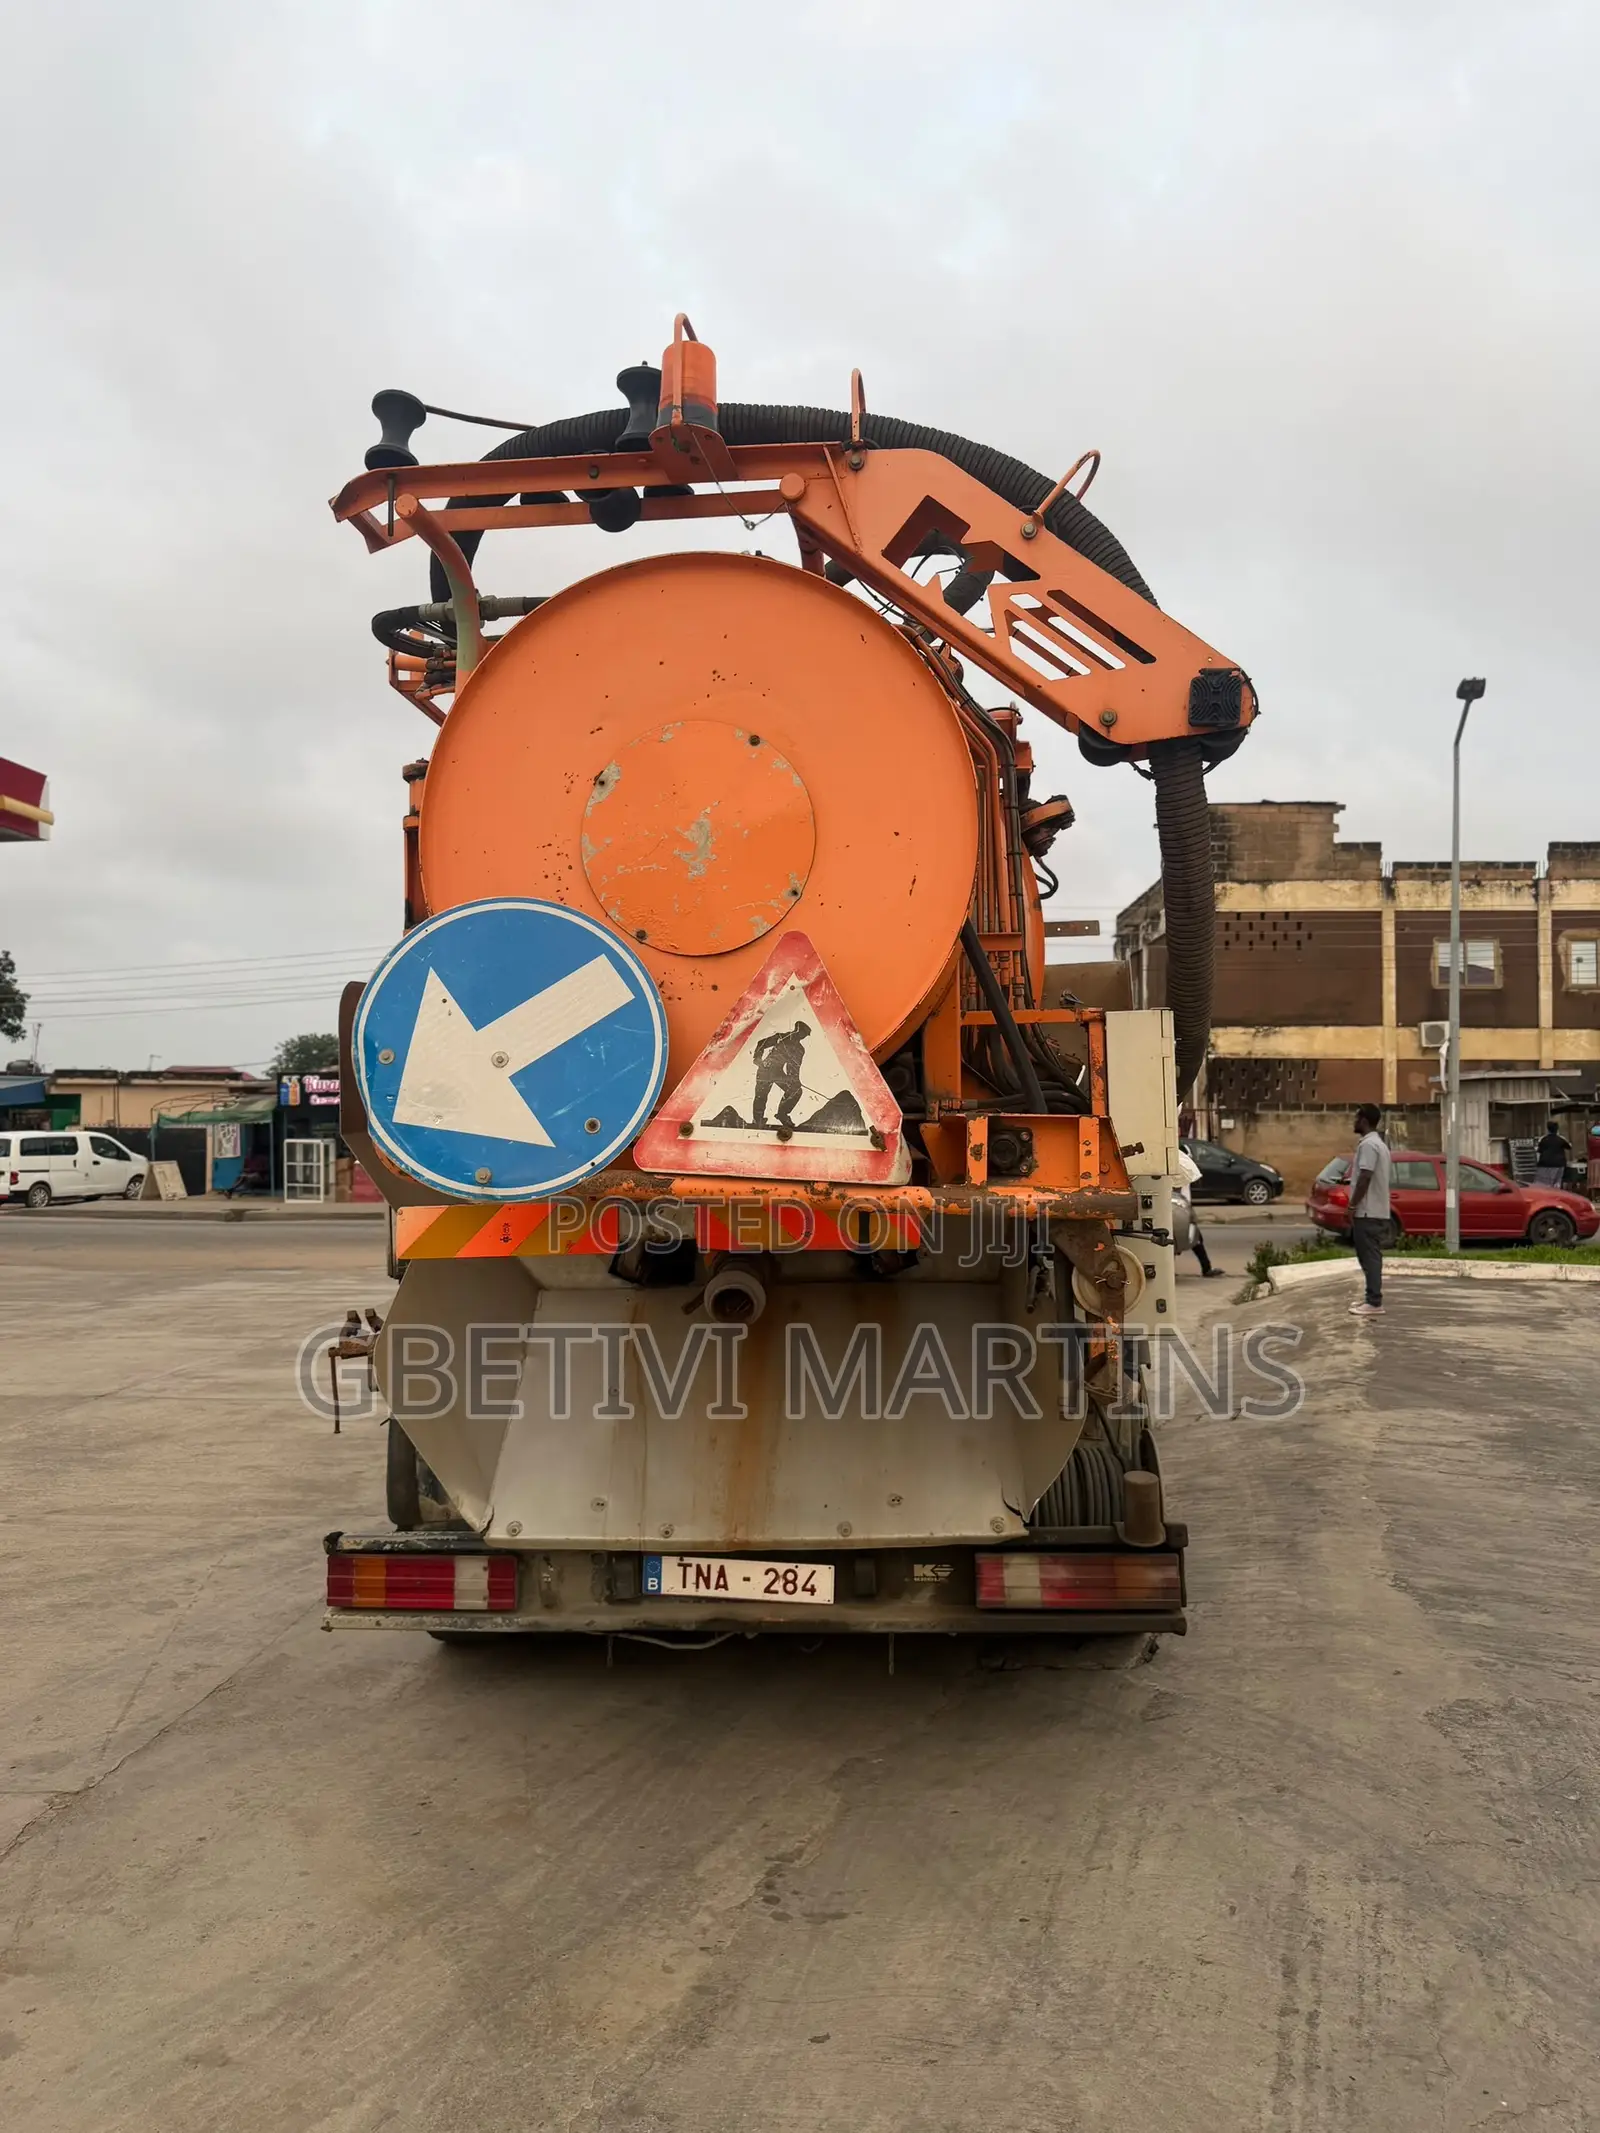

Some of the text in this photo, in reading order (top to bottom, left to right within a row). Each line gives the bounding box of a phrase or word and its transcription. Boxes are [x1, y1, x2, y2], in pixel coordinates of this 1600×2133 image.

[648, 1578, 659, 1590] B
[677, 1562, 729, 1591] TNA
[763, 1567, 817, 1596] 284
